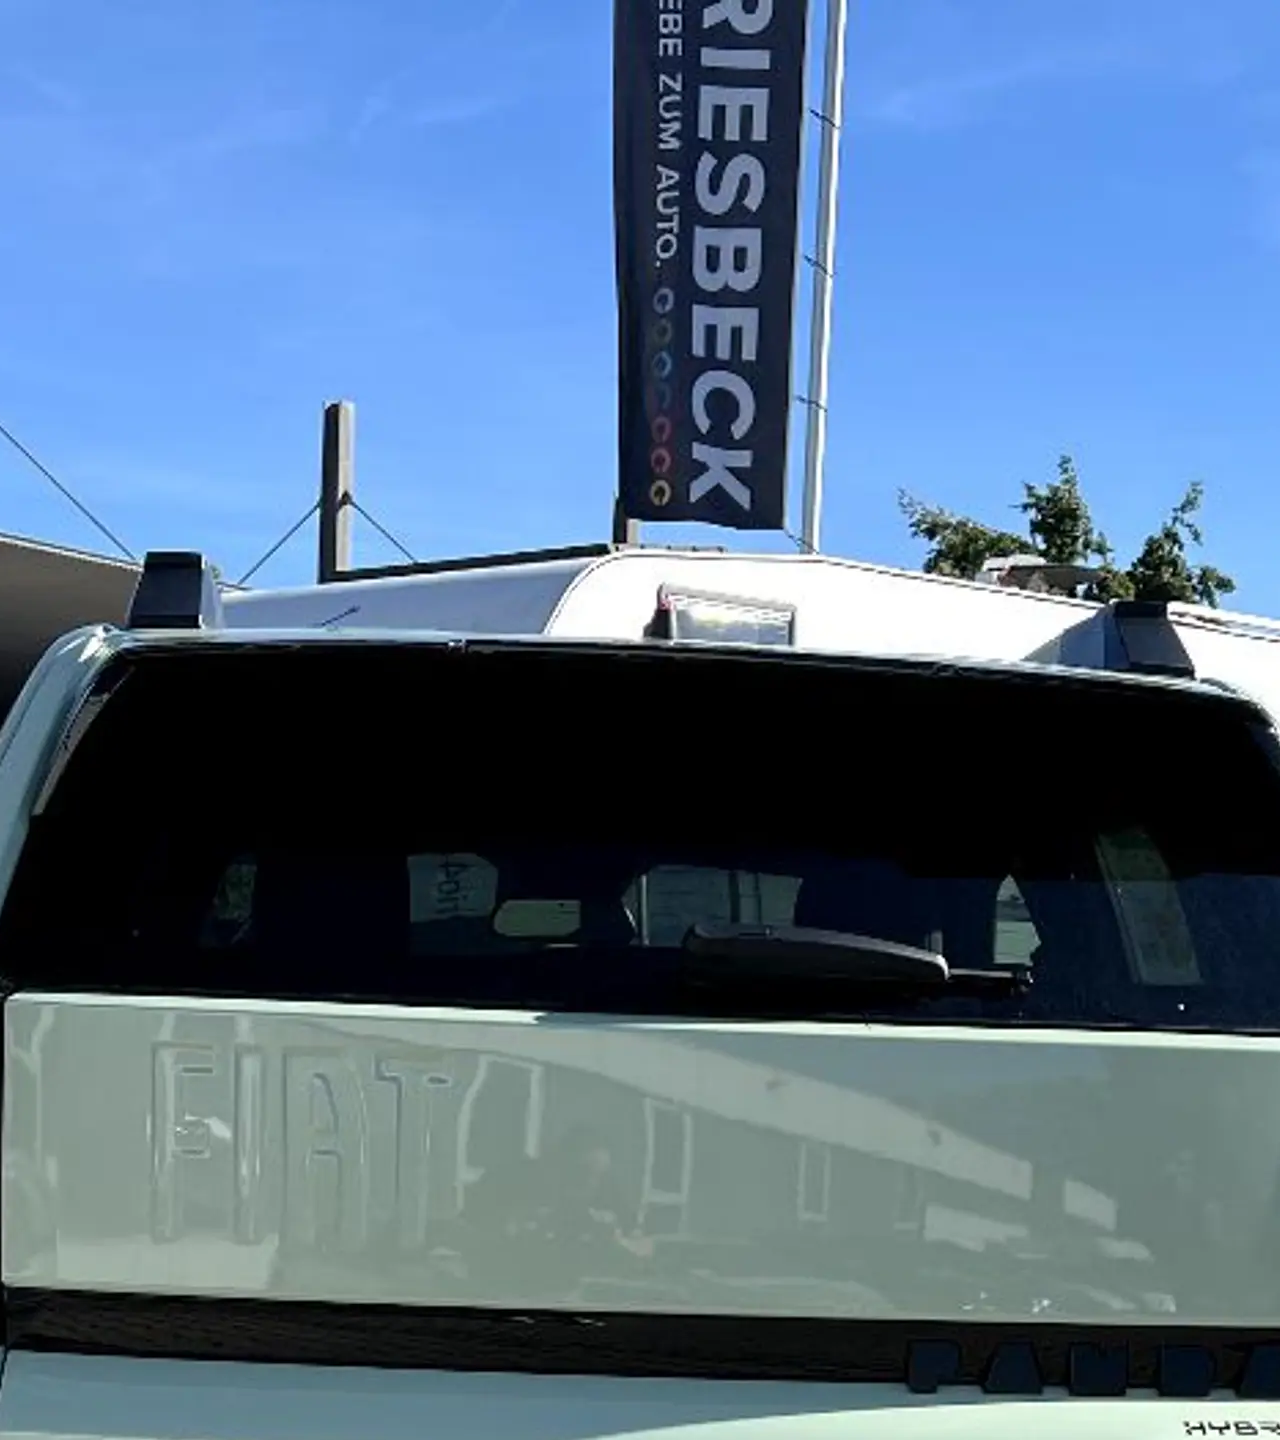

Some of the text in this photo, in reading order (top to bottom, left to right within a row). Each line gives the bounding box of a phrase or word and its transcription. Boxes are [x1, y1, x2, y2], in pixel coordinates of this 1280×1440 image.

[658, 73, 682, 150] ZUM
[655, 164, 680, 268] AUTO.
[150, 1040, 454, 1245] FIAT
